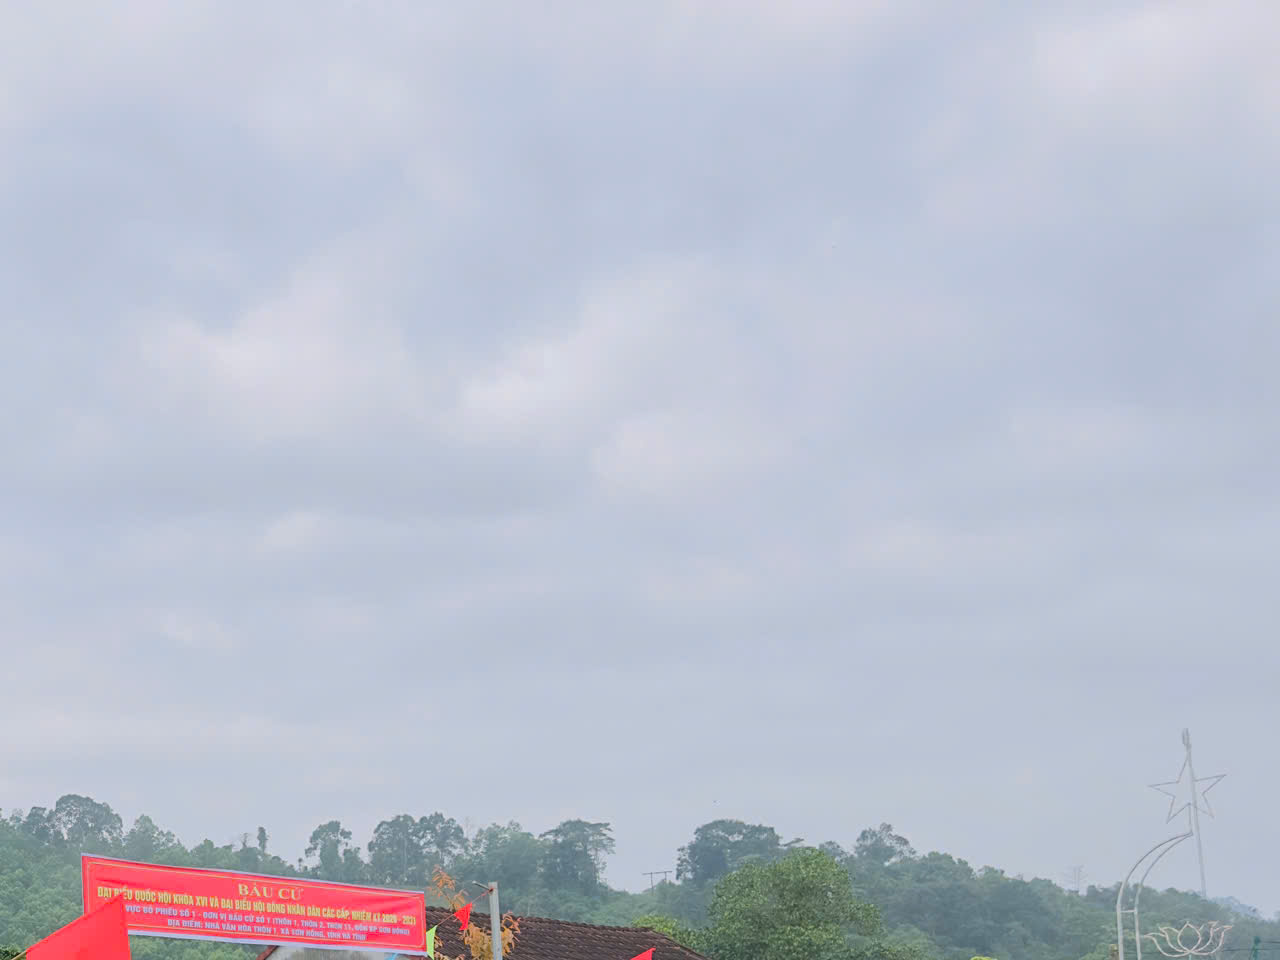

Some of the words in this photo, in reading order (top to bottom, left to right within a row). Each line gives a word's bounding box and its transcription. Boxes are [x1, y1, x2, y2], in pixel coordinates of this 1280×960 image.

[114, 886, 132, 900] BỂU
[135, 888, 156, 902] QUỐC
[158, 891, 171, 904] HỘI
[196, 896, 208, 907] XVI
[210, 897, 219, 908] VÀ
[221, 898, 233, 911] ĐẠI
[236, 897, 251, 911] BIỂU
[253, 901, 265, 914] HỘI
[287, 904, 305, 916] NHÂN
[322, 907, 335, 919] CÁC
